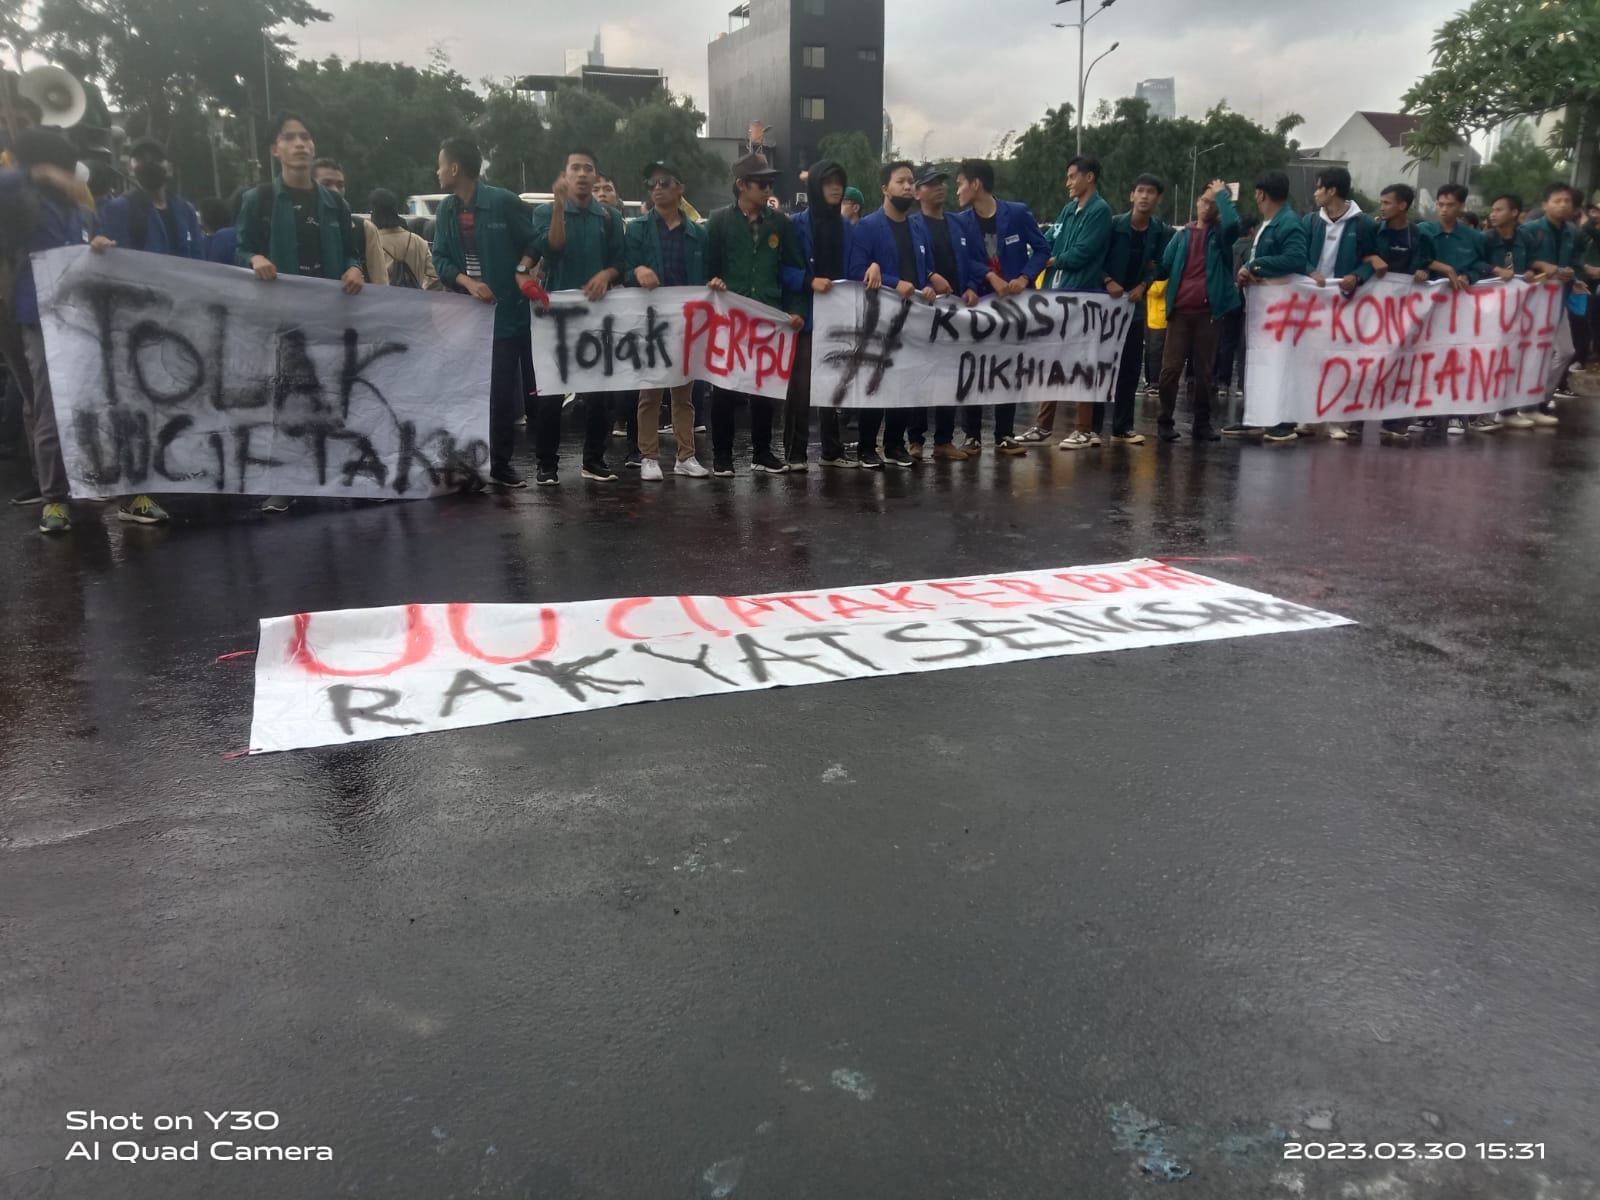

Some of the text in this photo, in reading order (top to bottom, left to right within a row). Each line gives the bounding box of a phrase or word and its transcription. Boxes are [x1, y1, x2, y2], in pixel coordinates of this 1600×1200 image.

[54, 277, 408, 420] TOLAK
[534, 305, 673, 384] Tolak
[1316, 341, 1553, 418] DIKHIANATI
[288, 602, 563, 677] UU
[326, 630, 884, 736] RAKYAT
